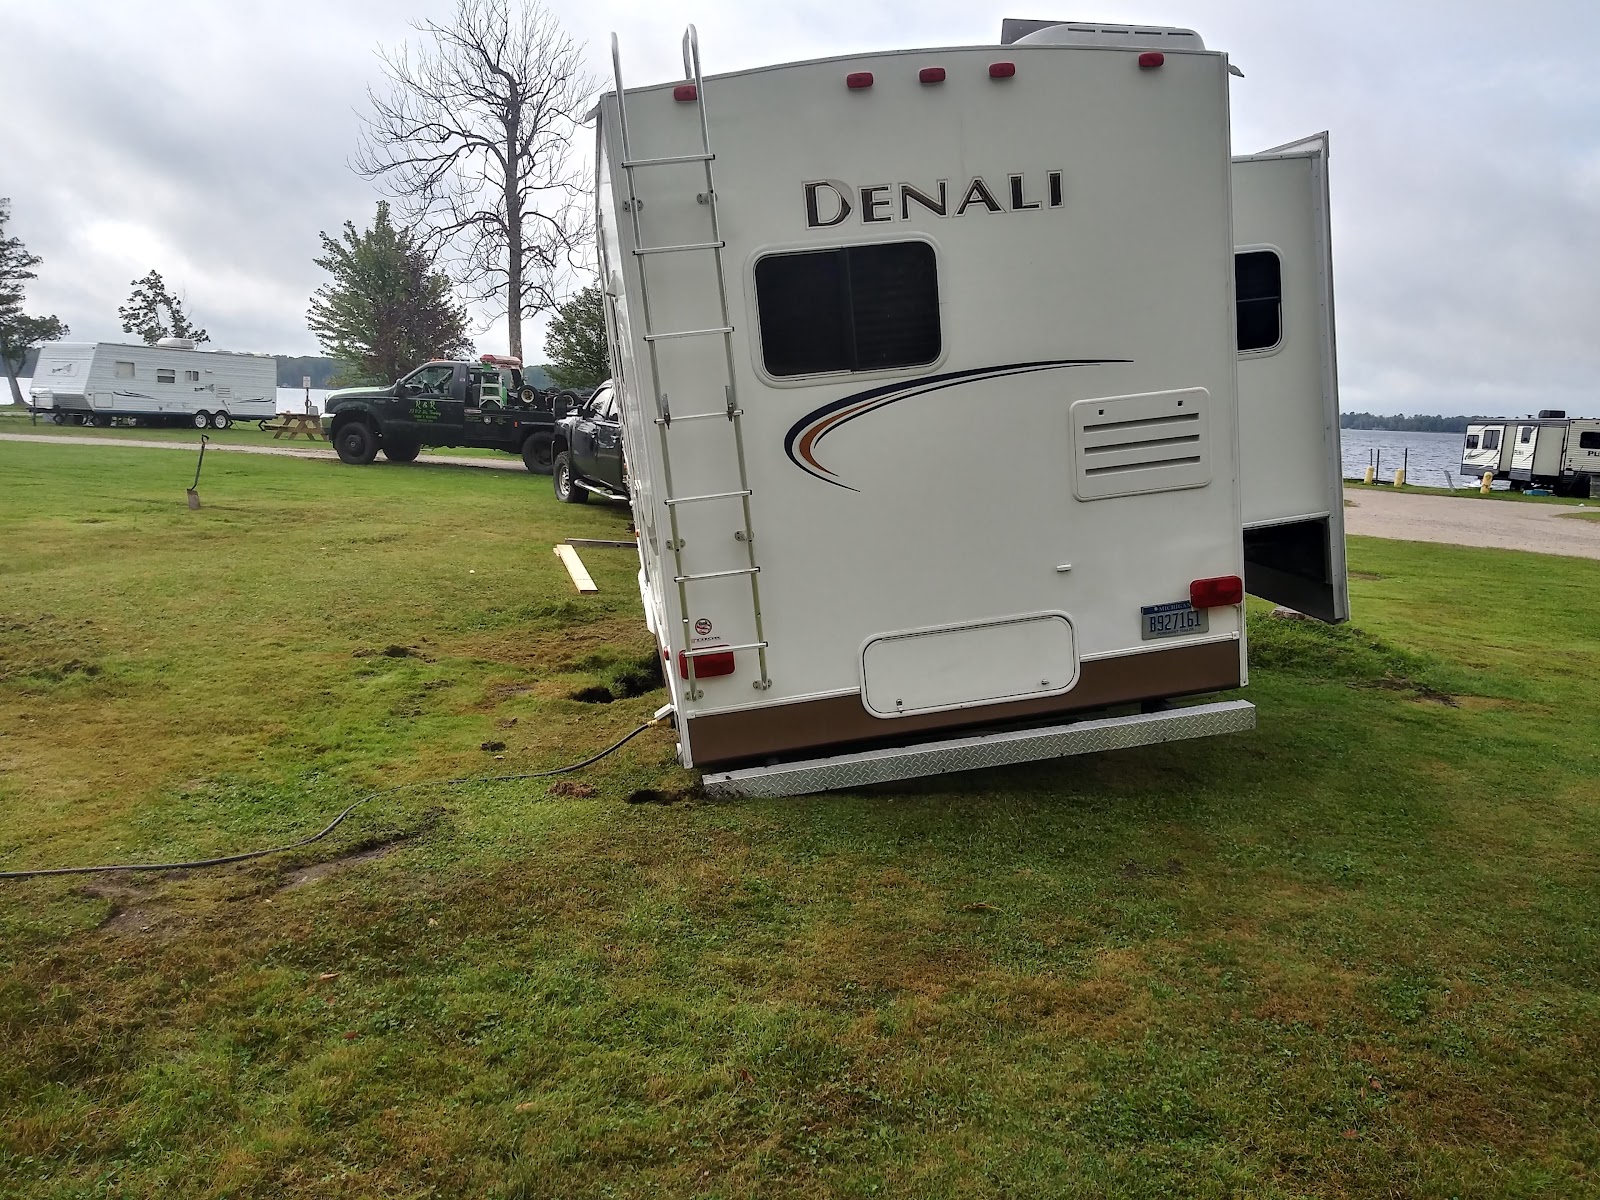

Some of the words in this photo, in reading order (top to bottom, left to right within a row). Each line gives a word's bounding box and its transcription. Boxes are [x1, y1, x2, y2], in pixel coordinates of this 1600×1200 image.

[801, 169, 1064, 230] DENALI
[415, 400, 421, 409] R
[430, 400, 436, 410] R
[1159, 602, 1192, 612] MICHIGAN
[1149, 610, 1201, 633] B927161
